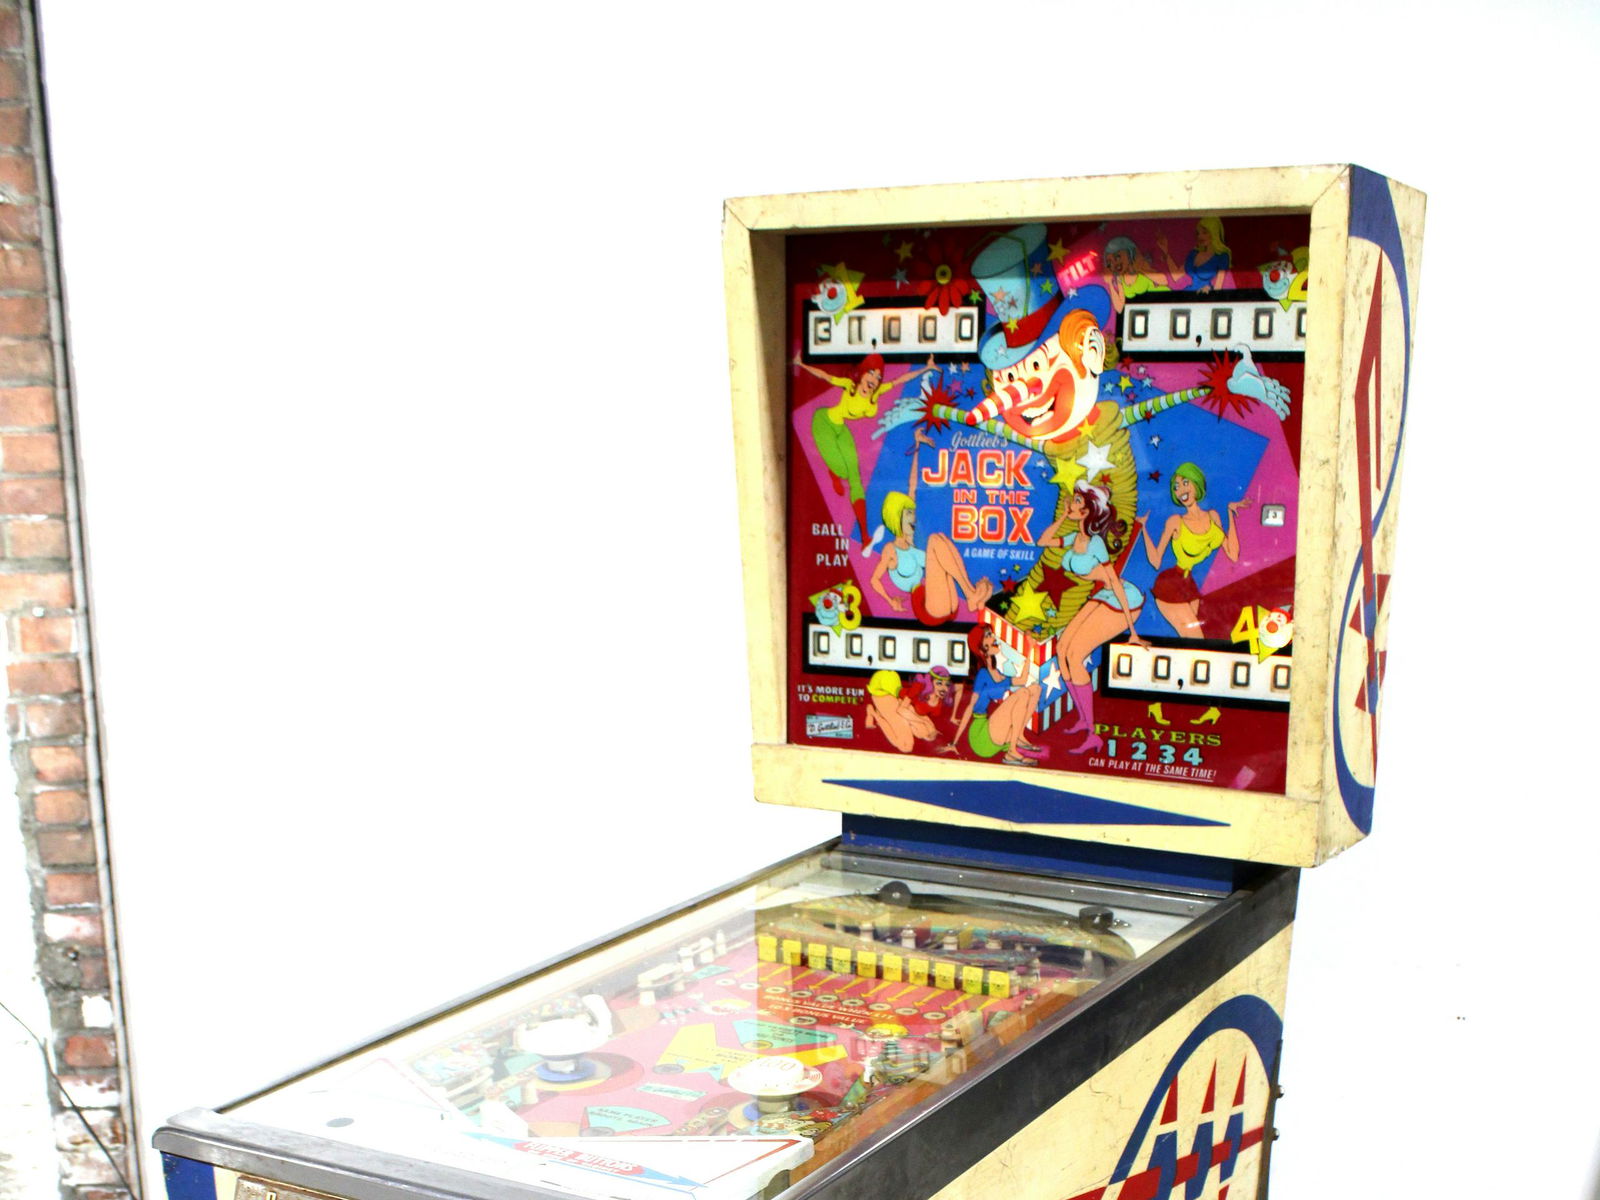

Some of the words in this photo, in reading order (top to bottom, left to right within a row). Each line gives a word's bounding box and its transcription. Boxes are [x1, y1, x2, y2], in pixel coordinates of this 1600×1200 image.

[1058, 255, 1096, 287] TILT
[949, 431, 1008, 452] Gottlieb's
[922, 448, 1034, 489] JACK
[953, 488, 977, 504] IN
[985, 489, 1030, 505] THE
[812, 523, 844, 536] BALL
[951, 504, 1036, 546] BOX
[835, 538, 849, 551] IN
[963, 547, 970, 558] A
[971, 548, 996, 559] GAME
[997, 549, 1008, 559] OF
[1009, 550, 1035, 561] SKILL
[816, 554, 849, 567] PLAY
[839, 585, 862, 630] 3
[1231, 606, 1260, 656] 4
[797, 684, 813, 693] IT'S
[815, 686, 843, 695] MORE
[846, 687, 865, 697] FUN
[798, 693, 810, 702] TO
[1094, 723, 1222, 746] PLAYERS
[1108, 739, 1116, 757] 1
[1131, 741, 1147, 760] 2
[1158, 744, 1176, 764] 3
[1183, 747, 1203, 766] 4
[1088, 757, 1105, 767] CAN
[1108, 760, 1130, 771] PLAY
[1132, 762, 1143, 772] AT
[1145, 763, 1161, 774] THE
[1164, 765, 1188, 777] SAME
[1191, 768, 1217, 779] TIME!
